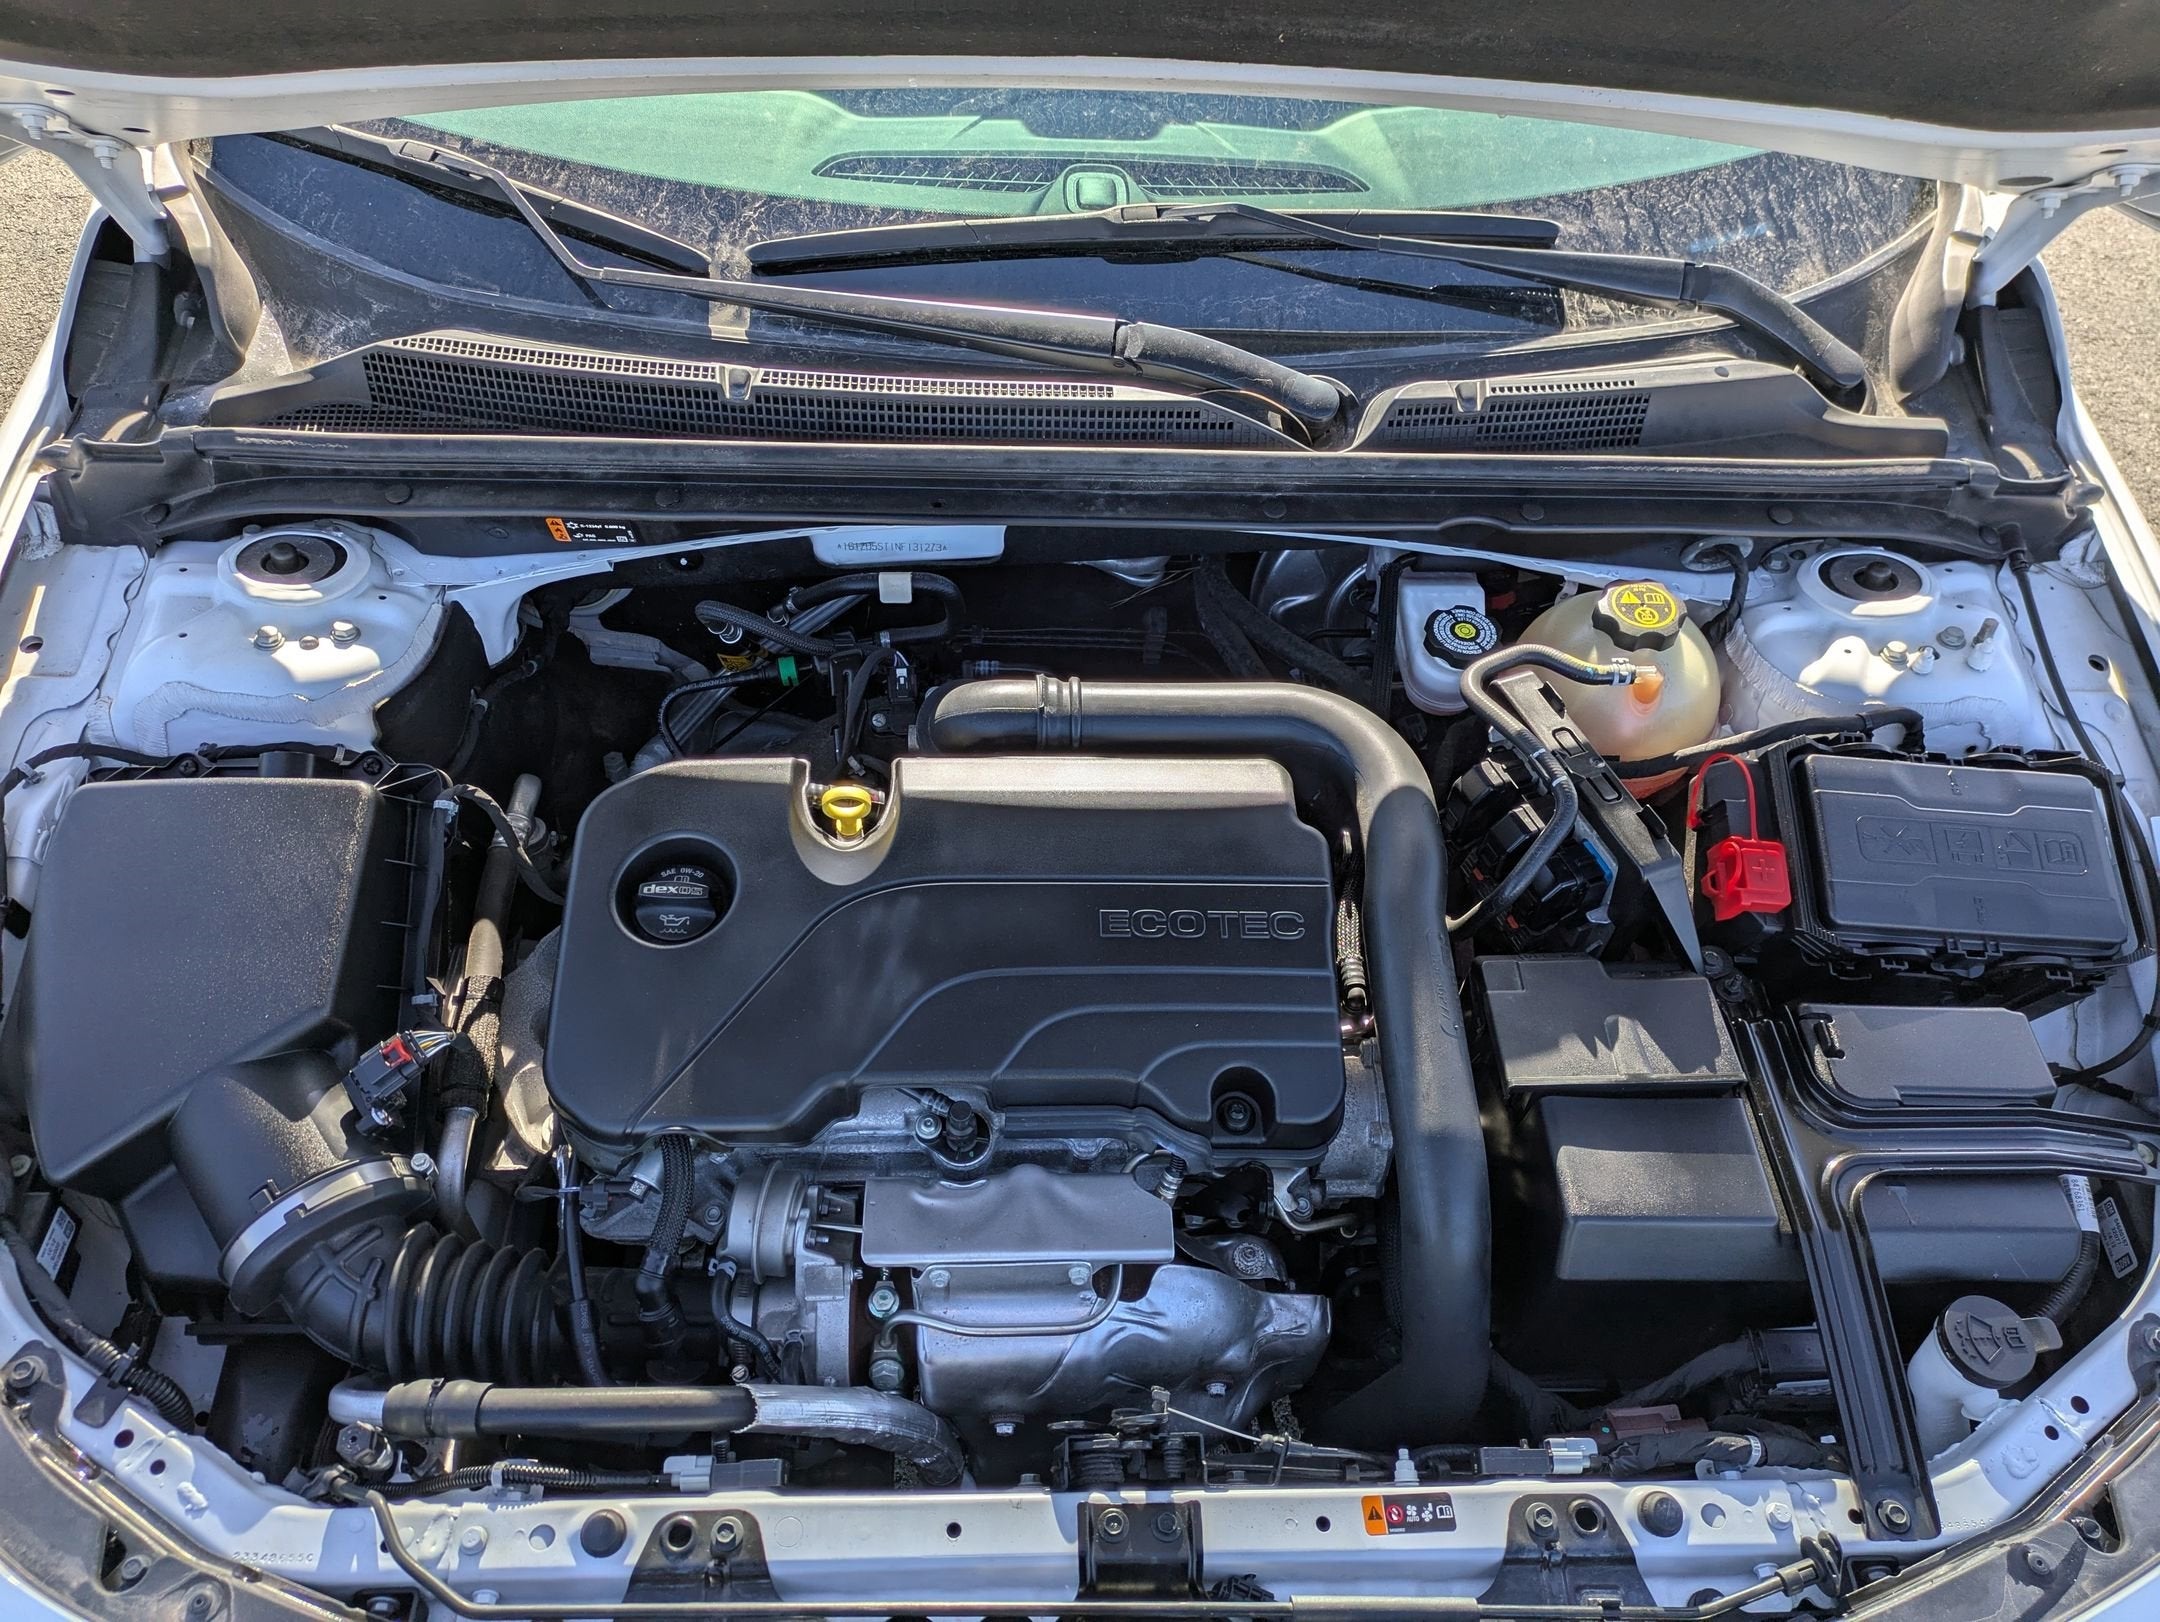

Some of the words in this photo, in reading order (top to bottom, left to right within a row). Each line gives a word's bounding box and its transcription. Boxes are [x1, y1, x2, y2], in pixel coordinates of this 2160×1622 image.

[660, 868, 676, 878] SAE
[680, 868, 704, 878] 0W-20
[643, 884, 703, 896] dexos
[1099, 909, 1305, 940] ECOTEC
